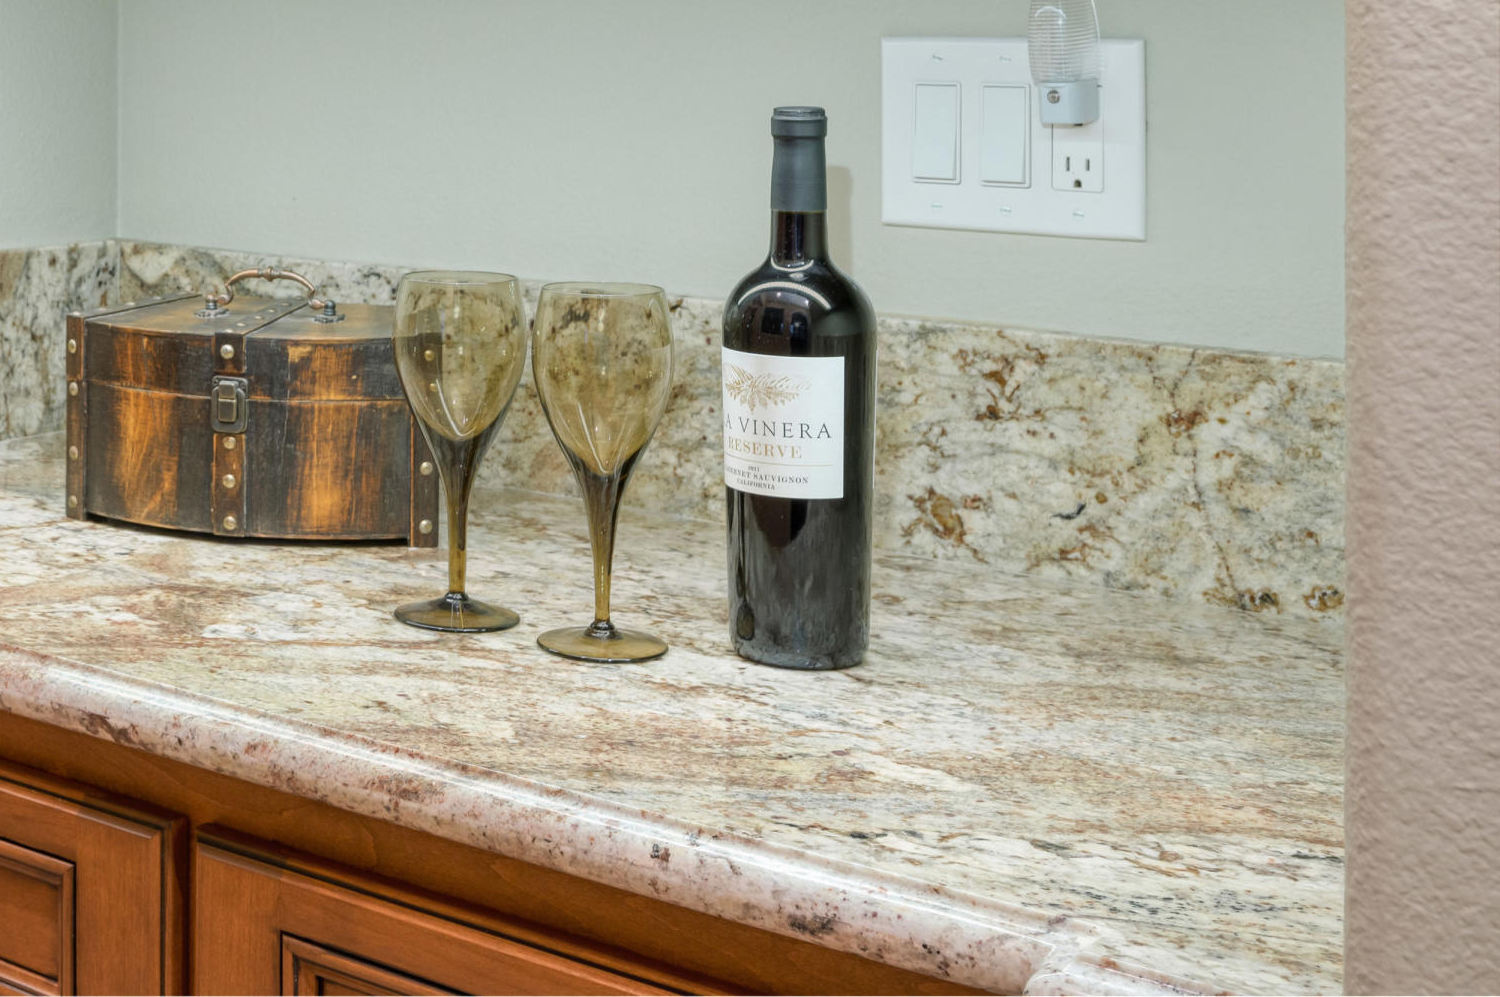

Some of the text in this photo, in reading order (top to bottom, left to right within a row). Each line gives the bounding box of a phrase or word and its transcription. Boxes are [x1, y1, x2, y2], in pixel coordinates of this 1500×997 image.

[738, 416, 832, 439] VINERA
[728, 436, 802, 459] RESERVE
[753, 470, 810, 484] SAUVIGNON
